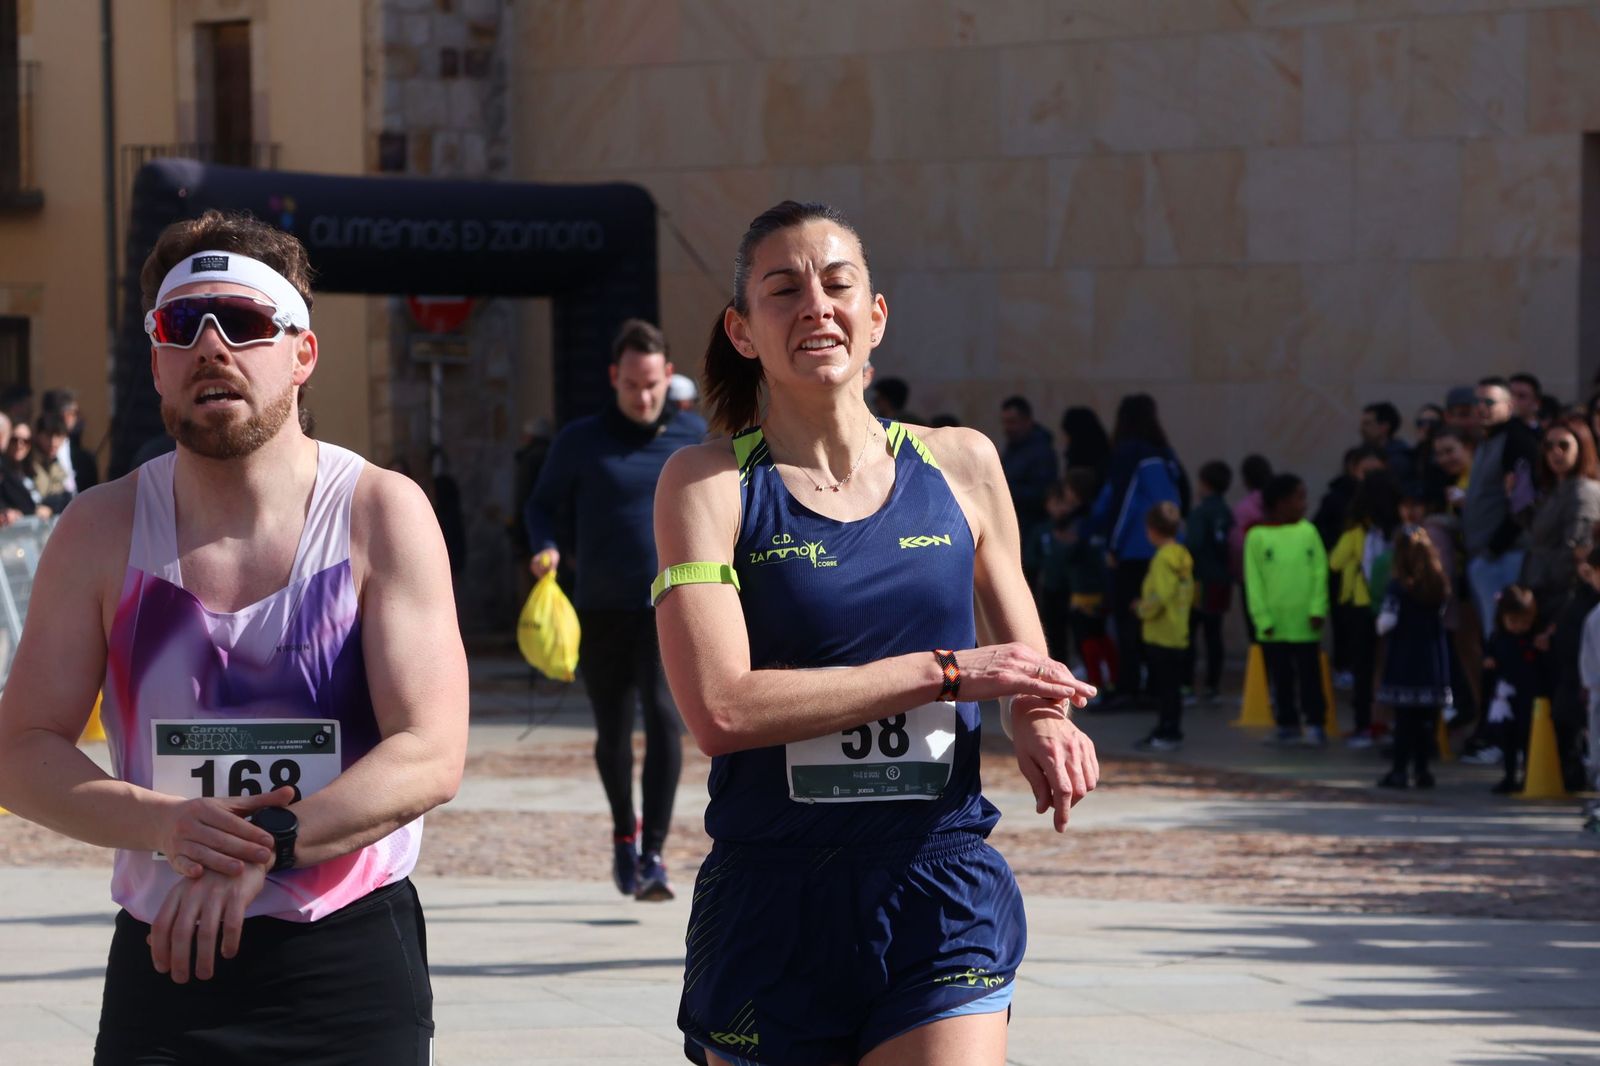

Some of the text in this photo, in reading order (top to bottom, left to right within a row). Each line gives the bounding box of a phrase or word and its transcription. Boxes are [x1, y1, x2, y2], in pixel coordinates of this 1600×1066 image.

[772, 533, 795, 545] C.D.
[899, 534, 952, 549] KON
[817, 560, 838, 568] CORRE
[841, 712, 910, 760] 58
[191, 759, 302, 805] 168
